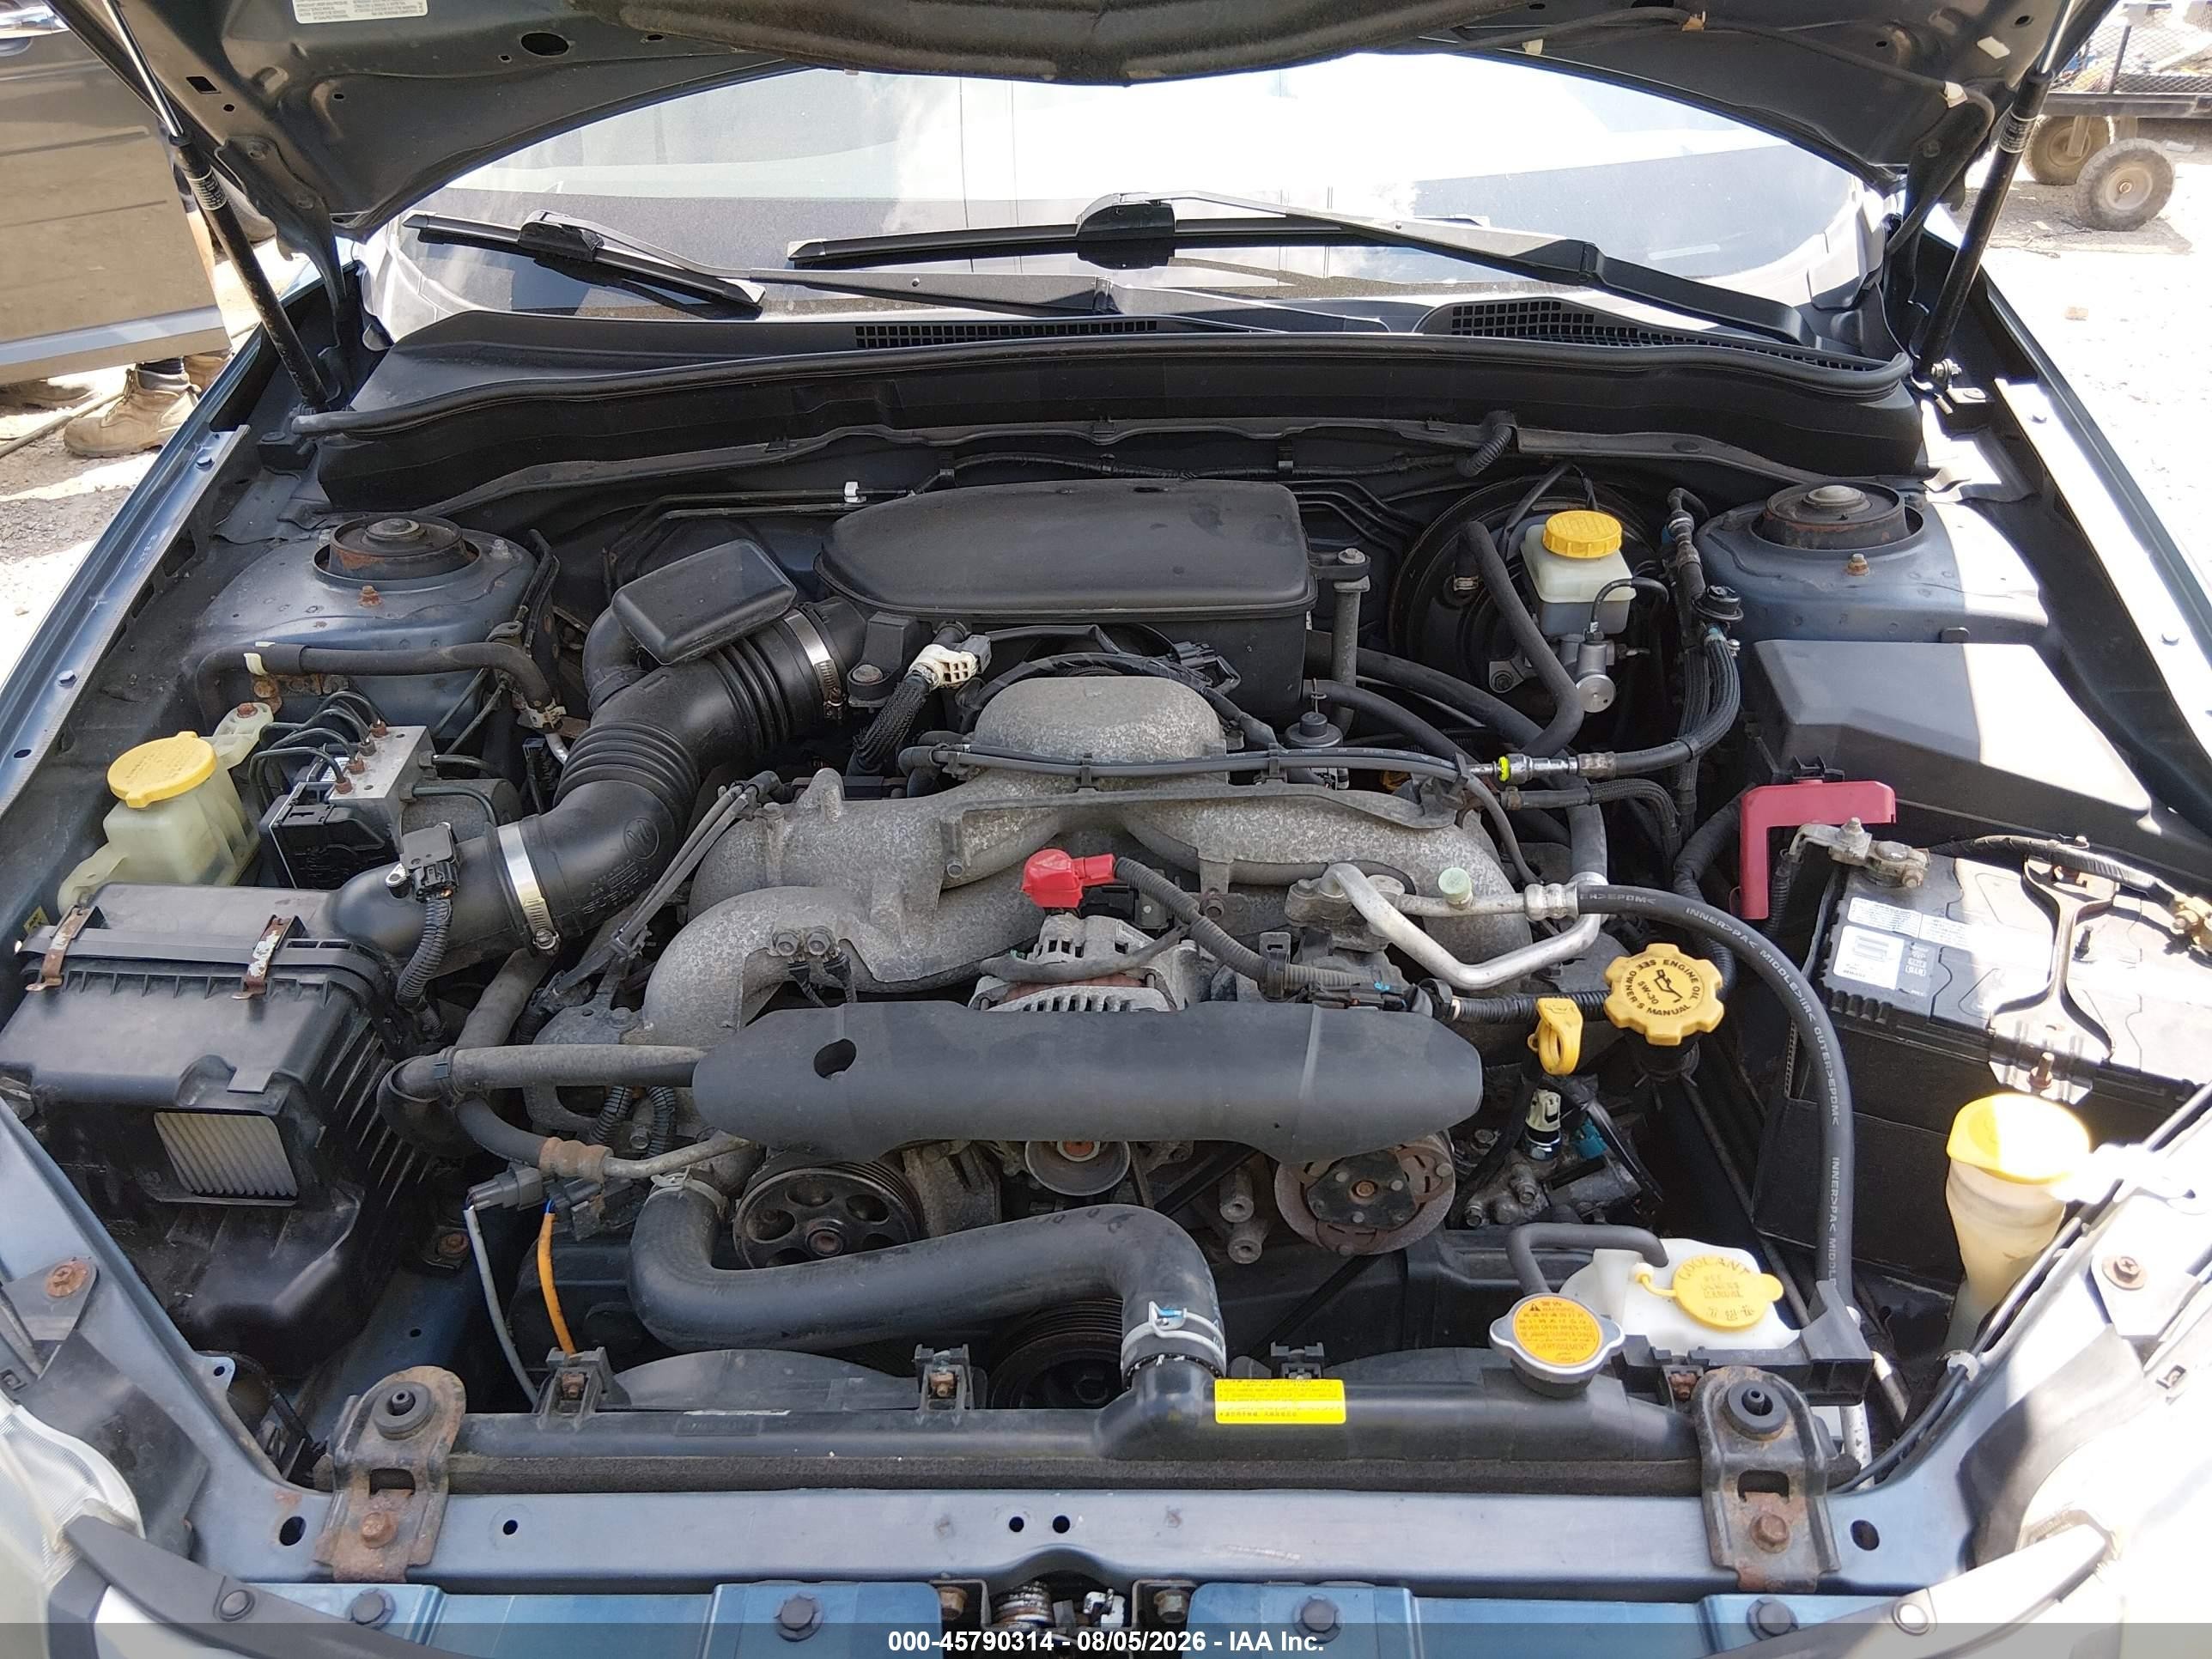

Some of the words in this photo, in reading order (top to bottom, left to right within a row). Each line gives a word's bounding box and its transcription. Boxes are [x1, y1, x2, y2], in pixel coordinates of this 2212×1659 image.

[1624, 969, 1646, 1010] OWNER'S
[1646, 1004, 1692, 1017] MANUAL
[1662, 958, 1699, 984] ENGINE
[1689, 985, 1701, 1000] OIL
[1814, 1026, 1840, 1127] OUTER>EPDM<
[1829, 1157, 1840, 1231] INNER>PA<
[1677, 1257, 1751, 1280] COOLANT
